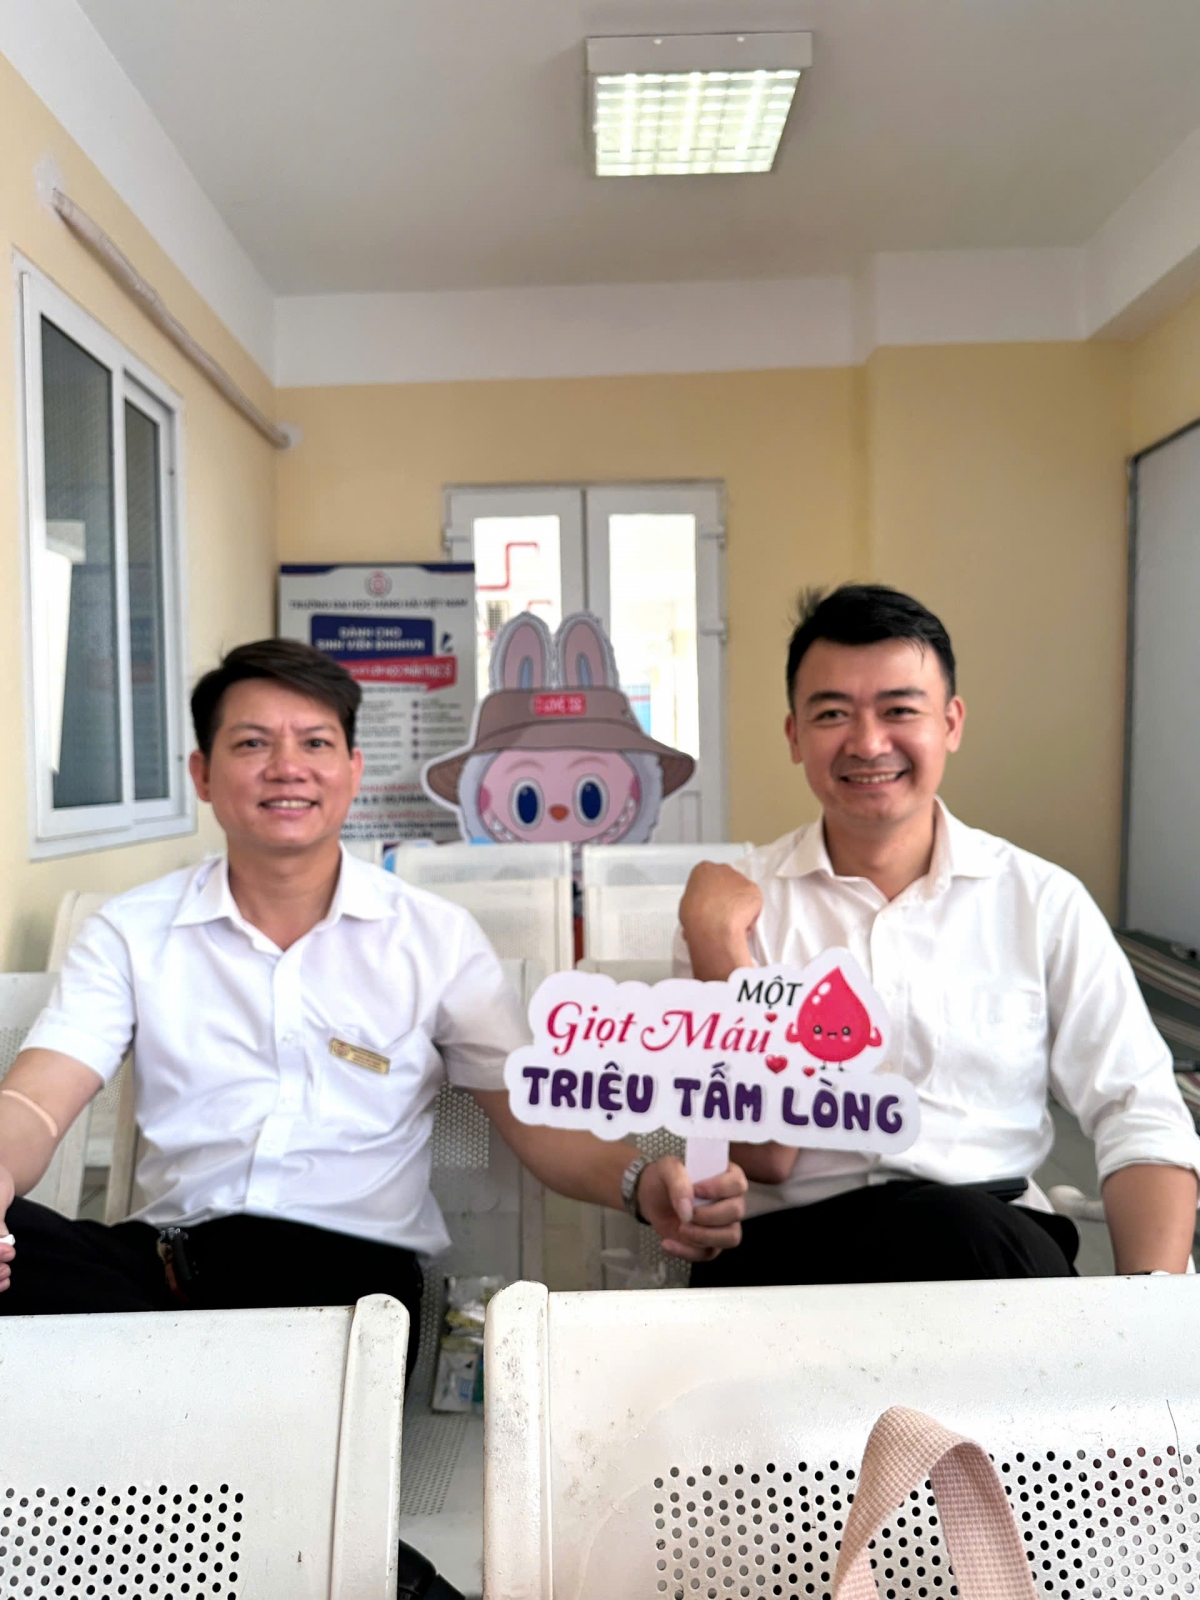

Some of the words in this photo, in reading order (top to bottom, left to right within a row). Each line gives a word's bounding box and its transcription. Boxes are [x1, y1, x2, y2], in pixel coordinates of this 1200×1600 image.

[736, 975, 803, 1010] MỘT
[546, 1000, 636, 1056] Giọt
[640, 1010, 773, 1054] Máu
[522, 1062, 655, 1121] TRIỆU
[674, 1061, 763, 1122] TẤM
[782, 1078, 904, 1135] LÒNG
